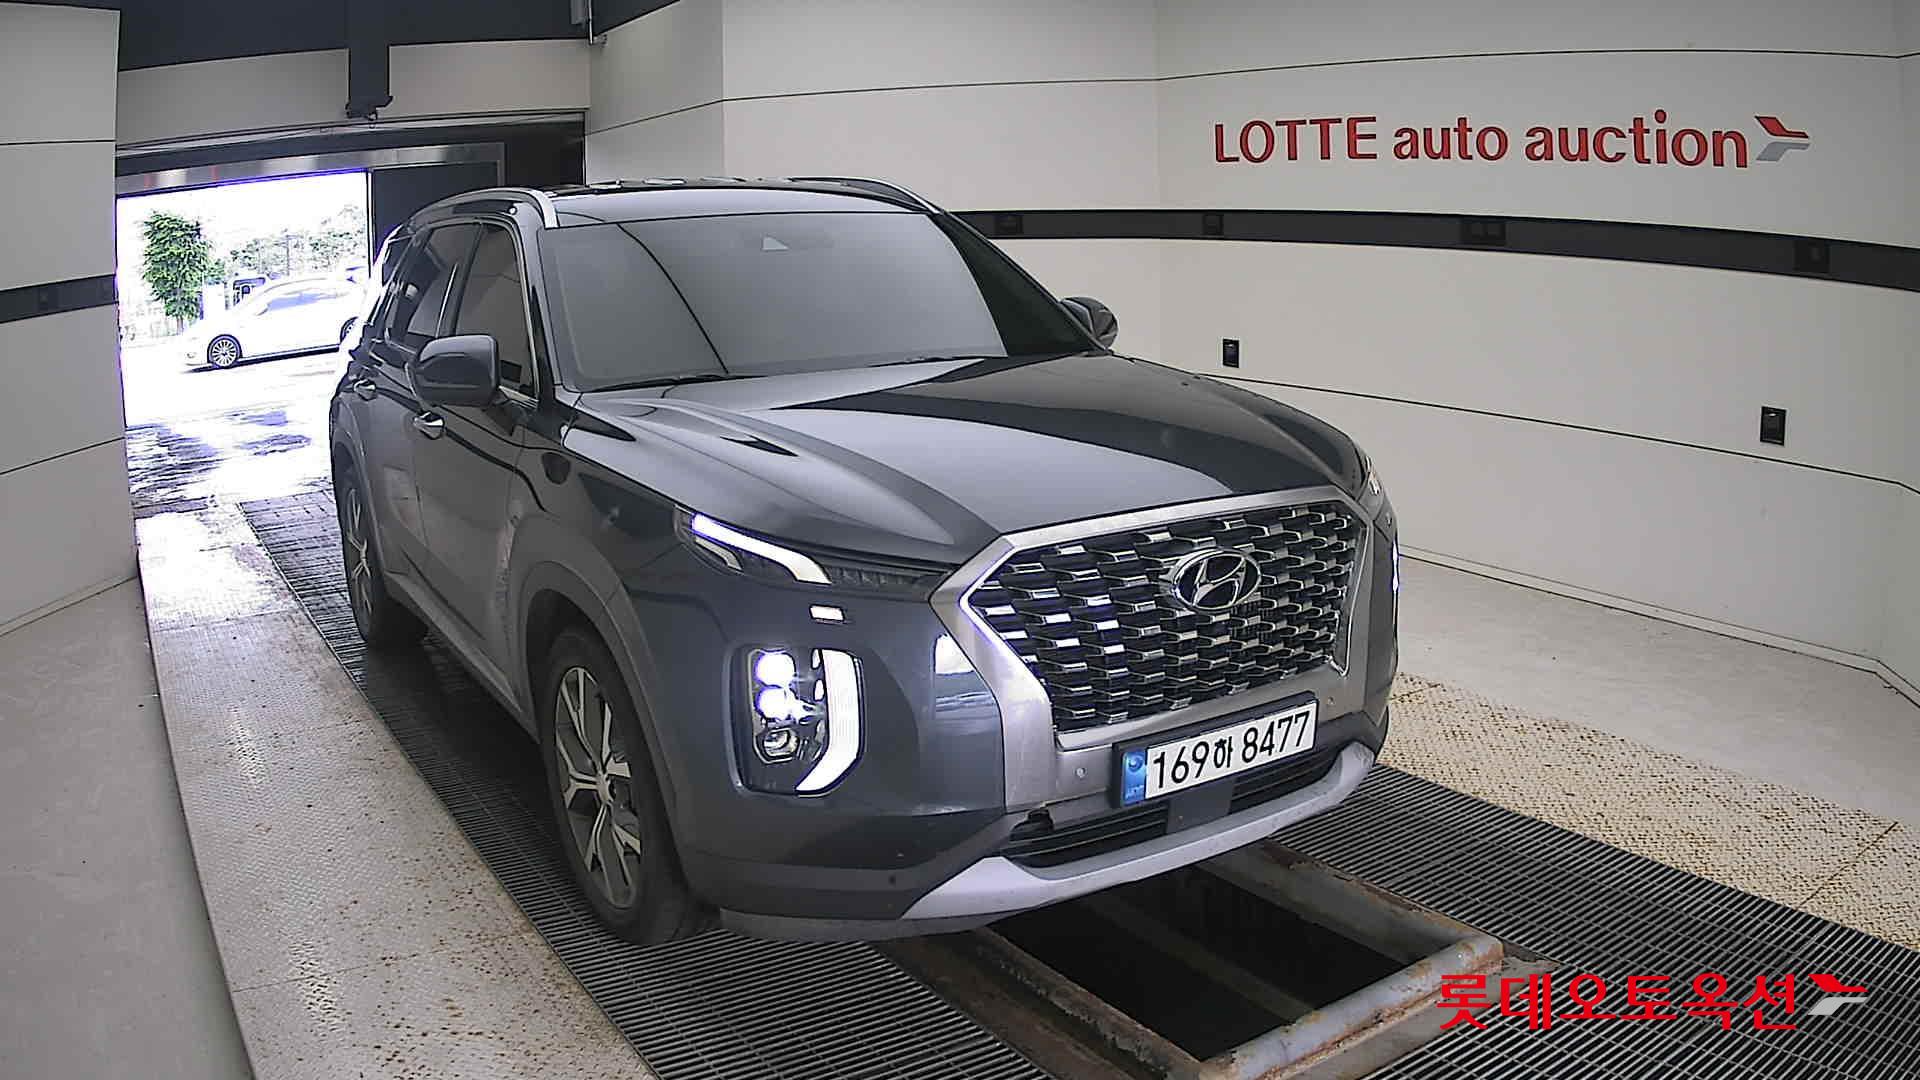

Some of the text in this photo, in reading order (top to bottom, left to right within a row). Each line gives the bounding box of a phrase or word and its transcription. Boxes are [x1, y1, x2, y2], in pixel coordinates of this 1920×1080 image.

[1214, 109, 1748, 168] LOTTE auto auction
[1153, 710, 1311, 788] 169하 8477
